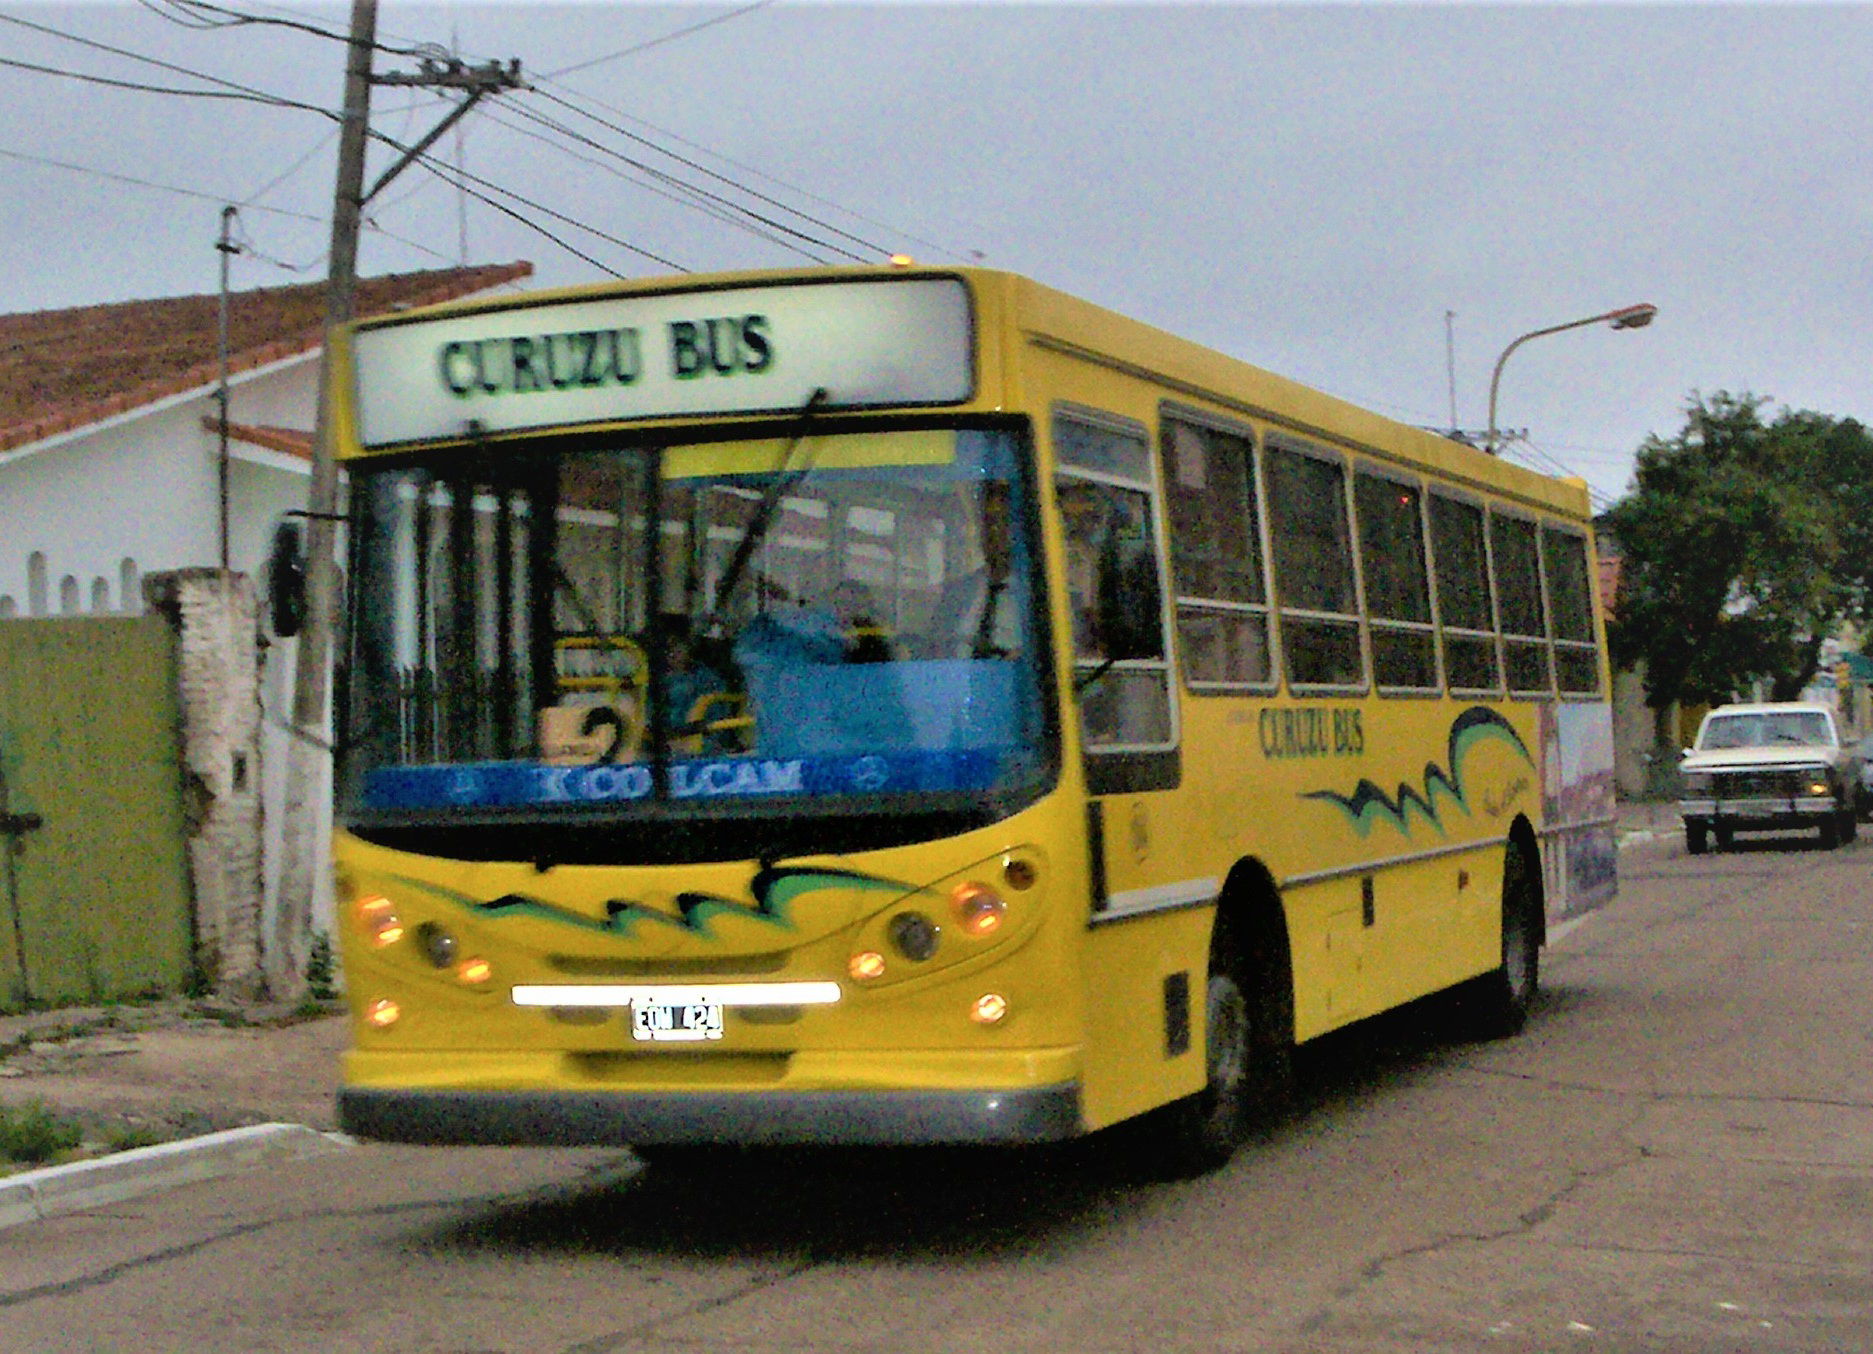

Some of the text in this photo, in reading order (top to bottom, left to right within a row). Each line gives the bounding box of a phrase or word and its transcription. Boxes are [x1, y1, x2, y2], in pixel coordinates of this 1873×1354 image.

[440, 314, 772, 395] CURUZU BUS
[1333, 707, 1365, 756] BUS
